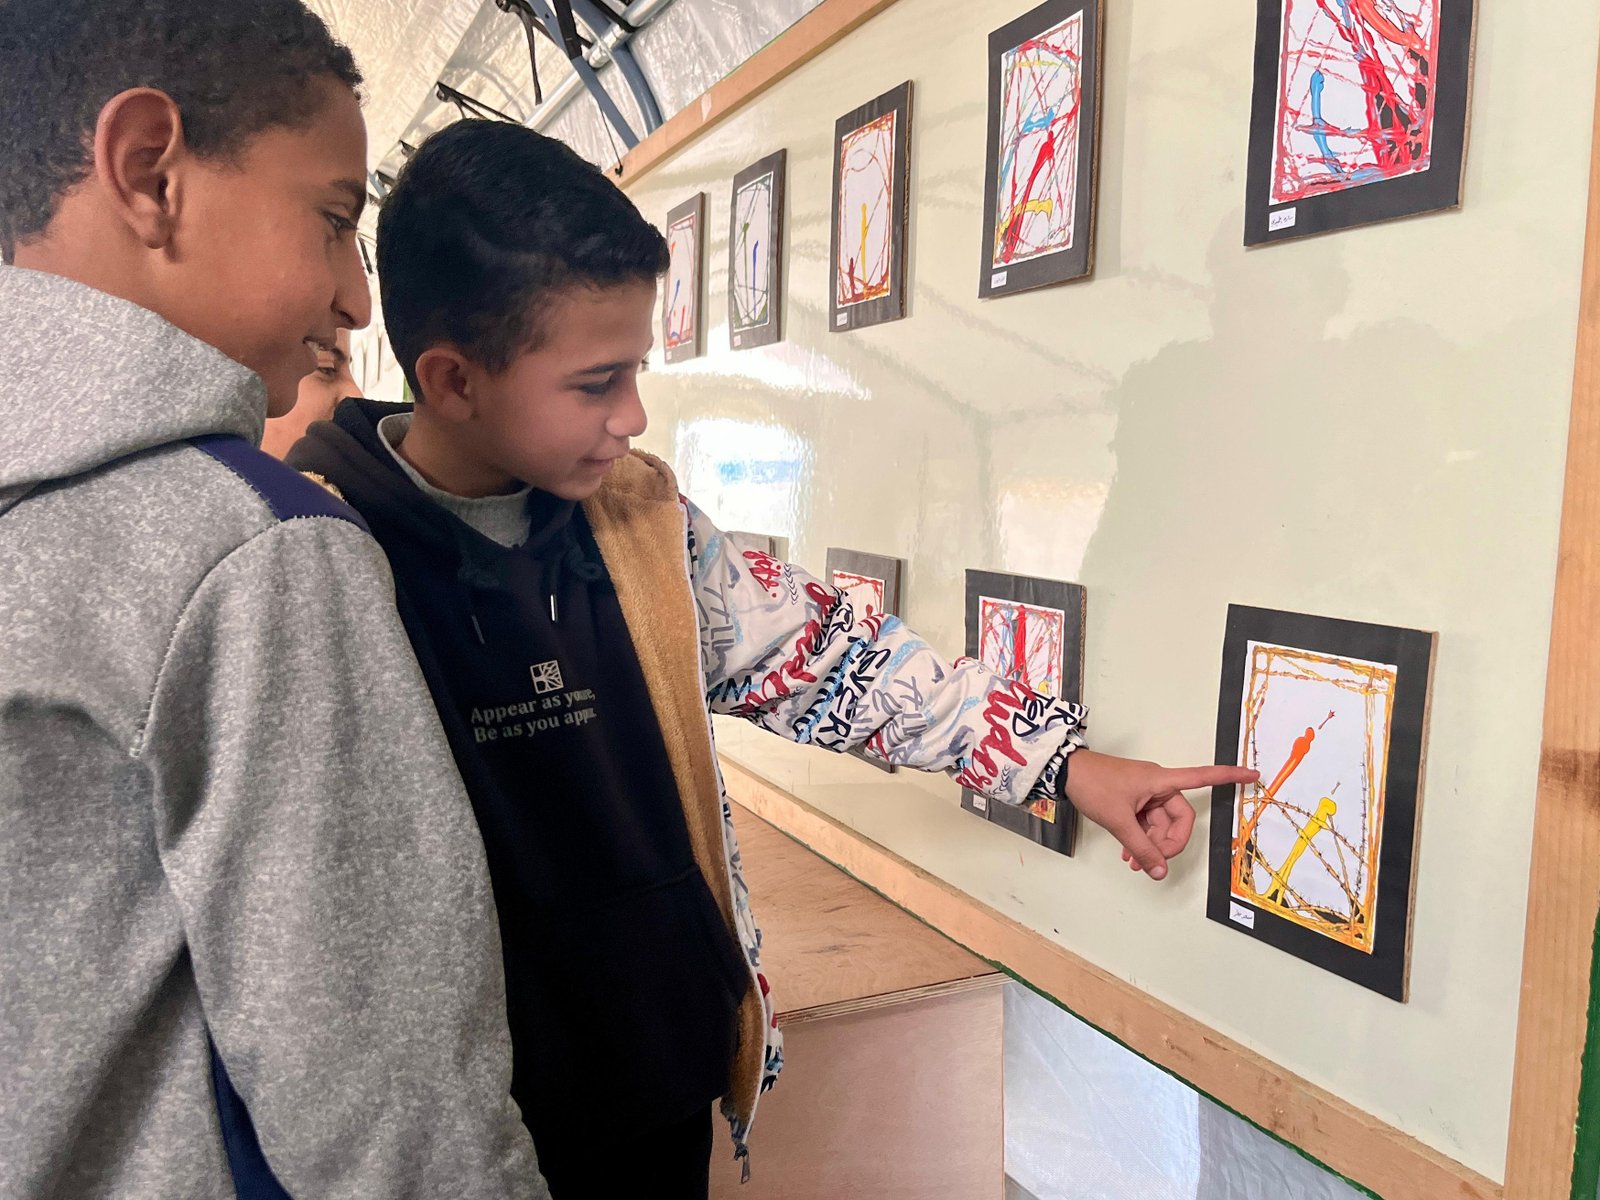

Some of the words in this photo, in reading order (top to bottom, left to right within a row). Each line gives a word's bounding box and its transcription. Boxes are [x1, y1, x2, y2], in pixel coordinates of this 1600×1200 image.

[470, 699, 537, 725] Appear
[541, 694, 562, 710] as
[473, 725, 499, 743] Be
[502, 723, 524, 738] as
[526, 715, 560, 737] you
